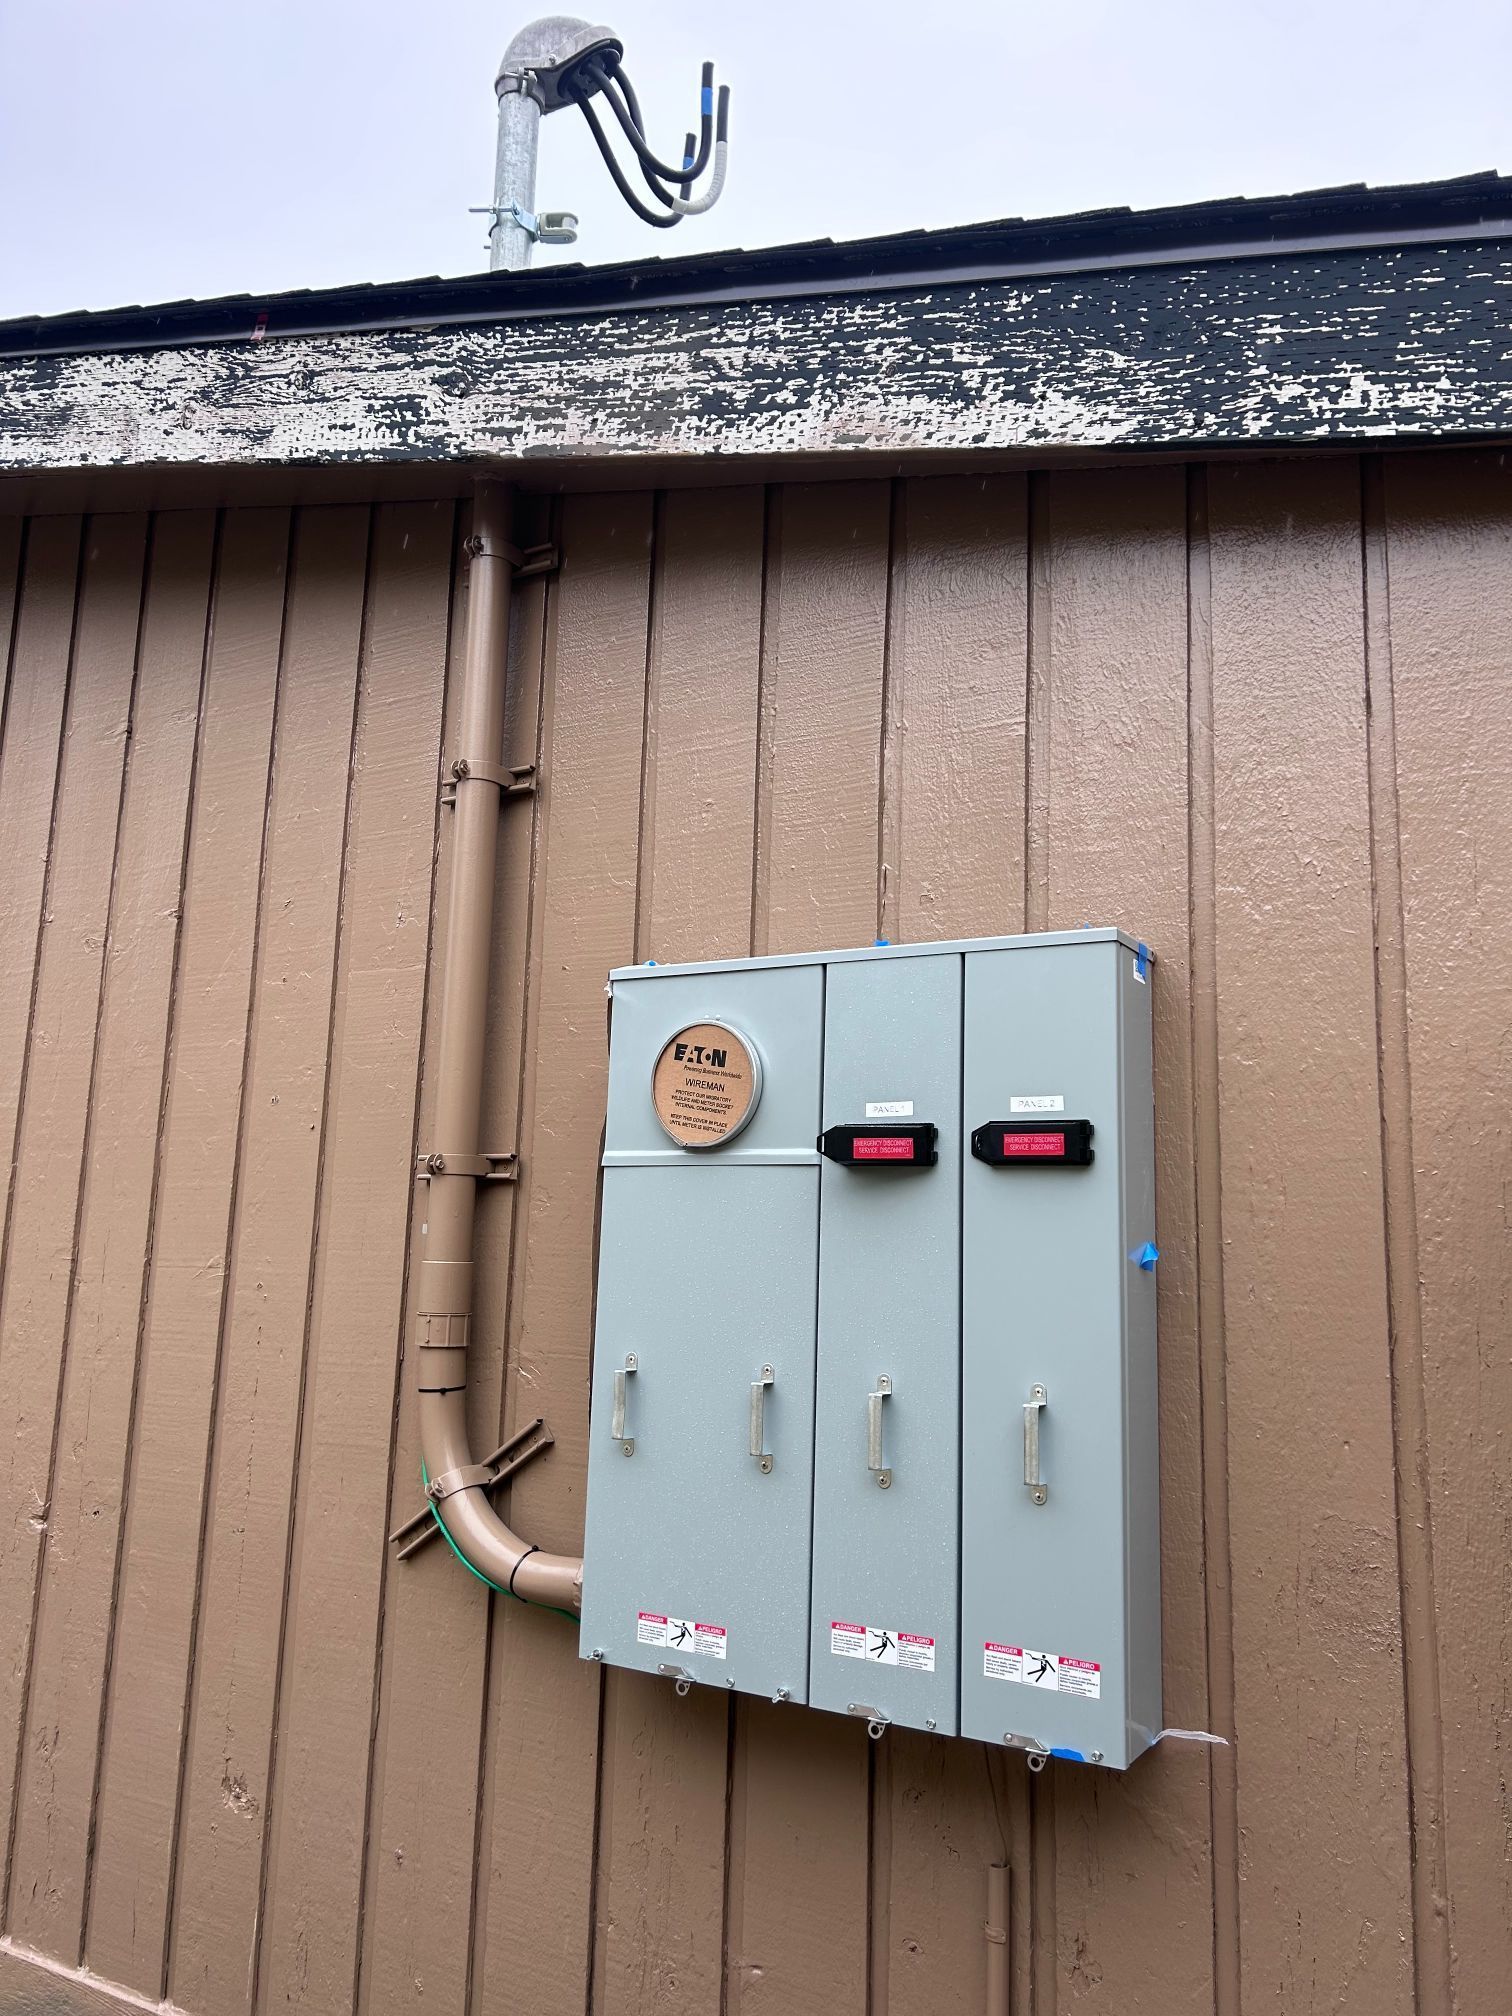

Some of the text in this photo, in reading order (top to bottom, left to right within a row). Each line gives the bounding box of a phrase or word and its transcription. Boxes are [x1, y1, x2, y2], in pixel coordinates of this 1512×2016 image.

[674, 1043, 727, 1067] EATON
[685, 1078, 725, 1092] WIREMAN
[703, 1626, 723, 1634] PELIGRO
[907, 1636, 930, 1644] PELIGRO
[994, 1645, 1017, 1655] DANGER
[1069, 1659, 1095, 1670] PELIGRO
